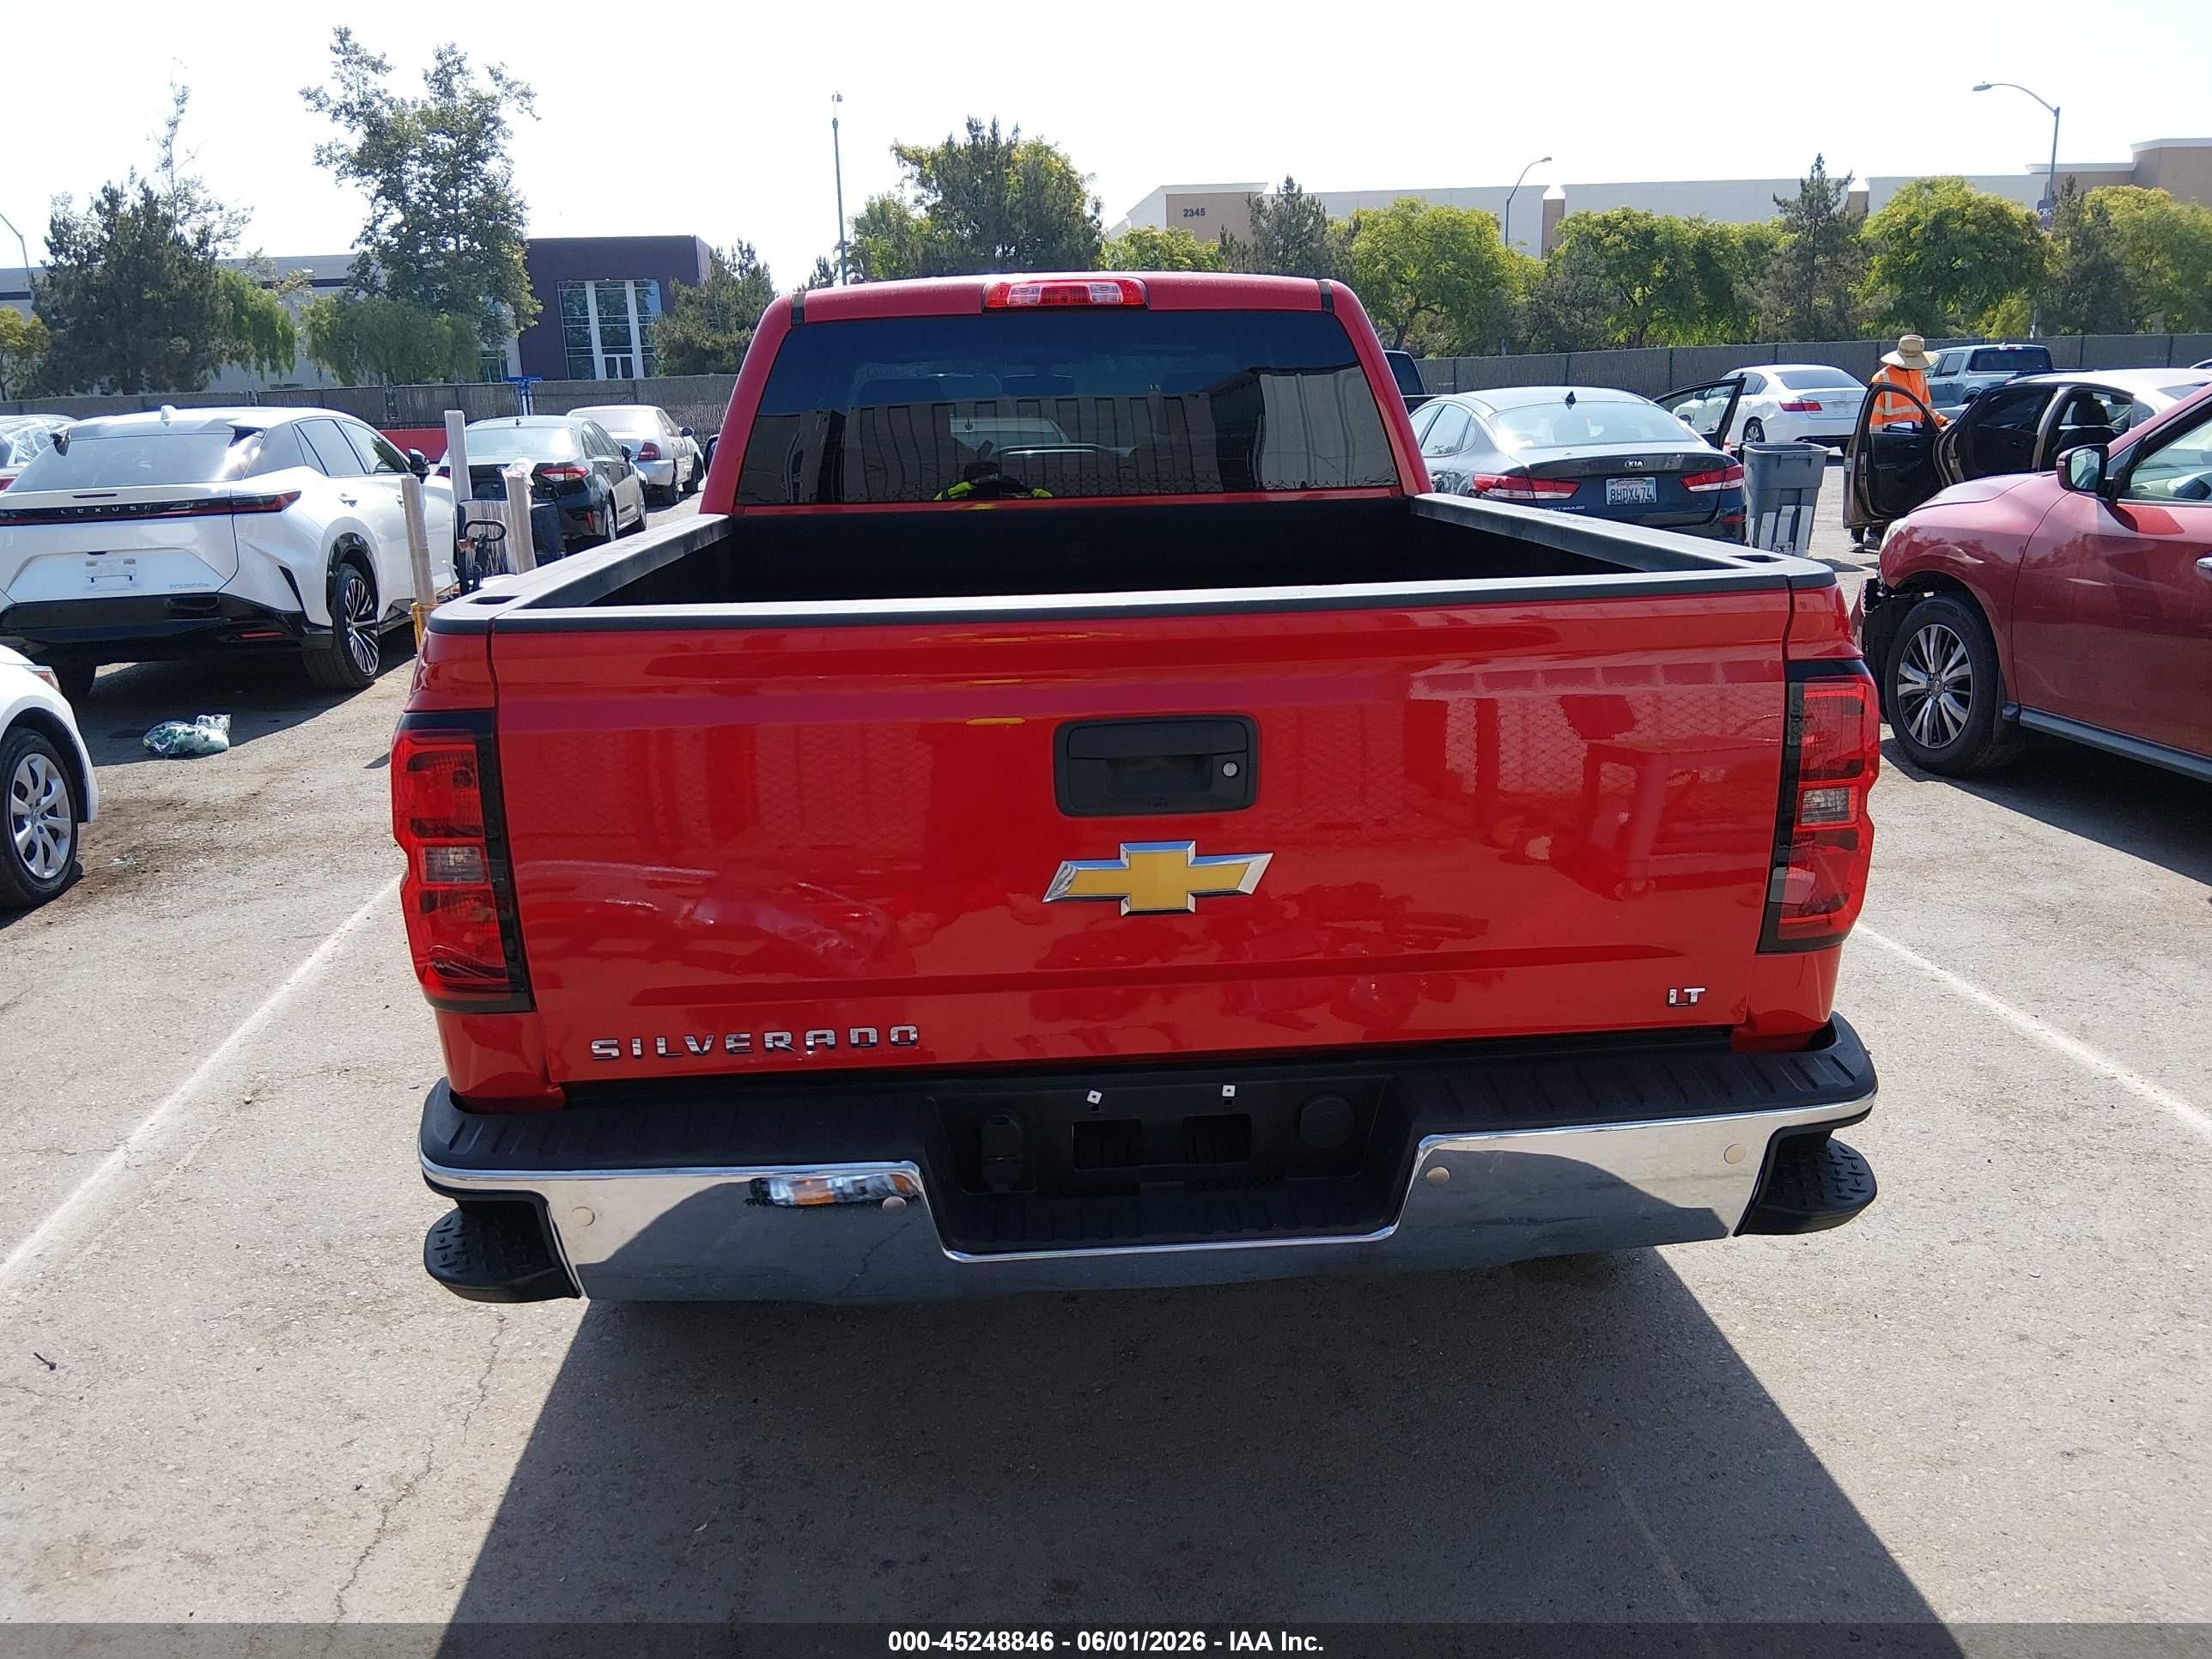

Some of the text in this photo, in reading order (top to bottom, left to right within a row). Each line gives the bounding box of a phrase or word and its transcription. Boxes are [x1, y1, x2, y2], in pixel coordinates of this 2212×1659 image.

[1182, 207, 1206, 217] 2345
[1610, 487, 1652, 501] 8HDX474
[60, 505, 138, 514] LEXUS
[1668, 987, 1706, 1006] LT
[590, 1024, 920, 1060] SILVERADO
